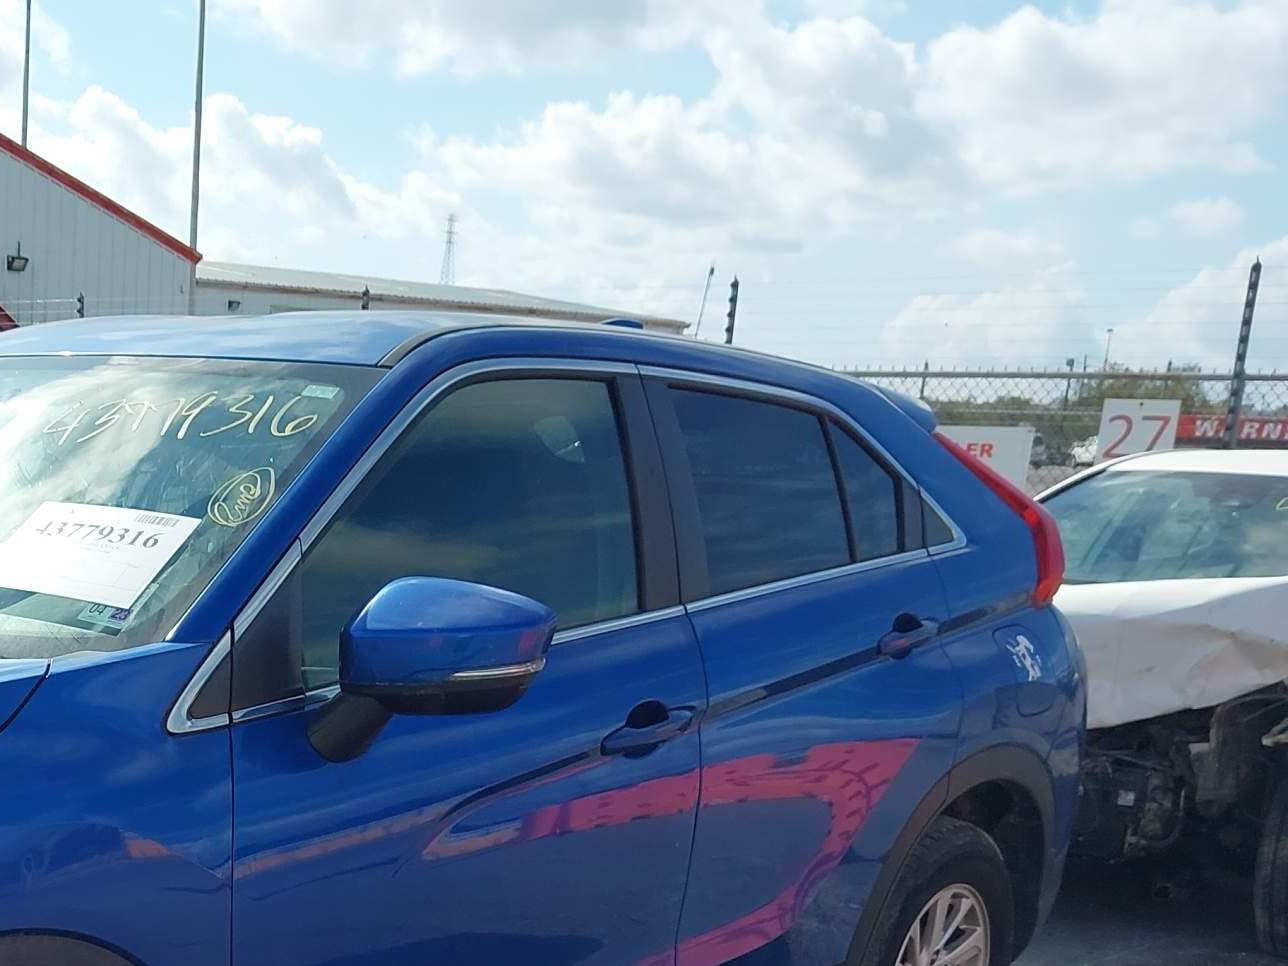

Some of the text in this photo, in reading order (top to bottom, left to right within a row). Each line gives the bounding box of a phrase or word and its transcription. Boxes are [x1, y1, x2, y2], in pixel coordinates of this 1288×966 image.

[1103, 414, 1171, 459] 27
[1194, 418, 1288, 440] WRN
[35, 520, 167, 549] 43779316
